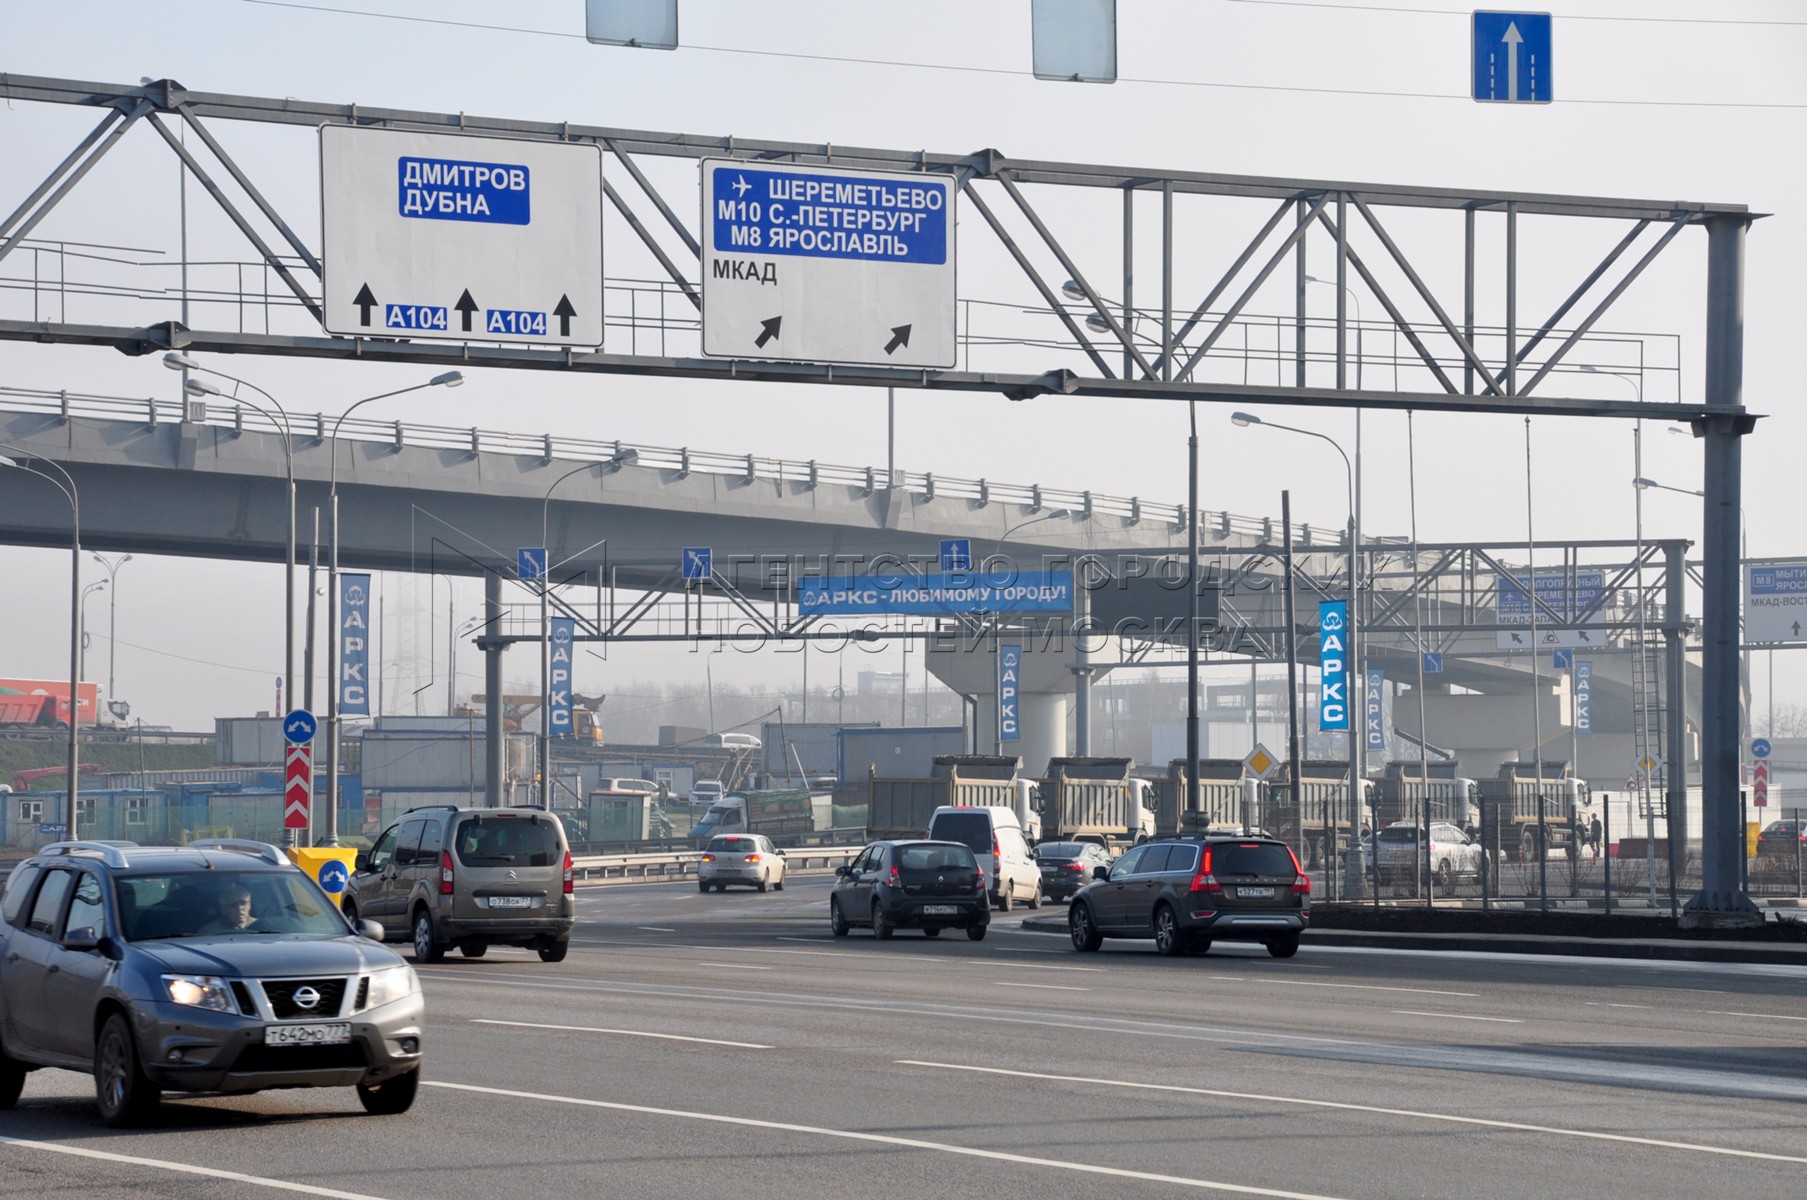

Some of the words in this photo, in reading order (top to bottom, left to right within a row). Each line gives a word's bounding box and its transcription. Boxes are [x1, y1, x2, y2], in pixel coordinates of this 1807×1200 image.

[404, 162, 526, 191] ДМИТРОВ
[404, 190, 490, 215] ДУБНА
[769, 178, 942, 210] ШЕРЕМЕТЬЕВО
[718, 200, 761, 222] М10
[769, 203, 927, 233] С.-ПЕТЕРБУРГ
[731, 225, 762, 247] М8
[769, 228, 908, 256] ЯРОСЛАВЛЬ
[713, 259, 777, 285] МКАД
[387, 307, 446, 329] А104
[488, 312, 545, 334] А104
[817, 590, 878, 605] АРКС
[890, 586, 990, 603] ЛЮБИМОМУ
[995, 585, 1067, 603] ГОРОДУ!
[1756, 576, 1772, 585] М8
[343, 610, 366, 704] АРКС
[552, 648, 570, 725] АРКС
[1322, 635, 1344, 722] АРКС
[1002, 669, 1016, 733] АРКС
[1368, 689, 1381, 744] АРКС
[1577, 680, 1590, 729] АРКС
